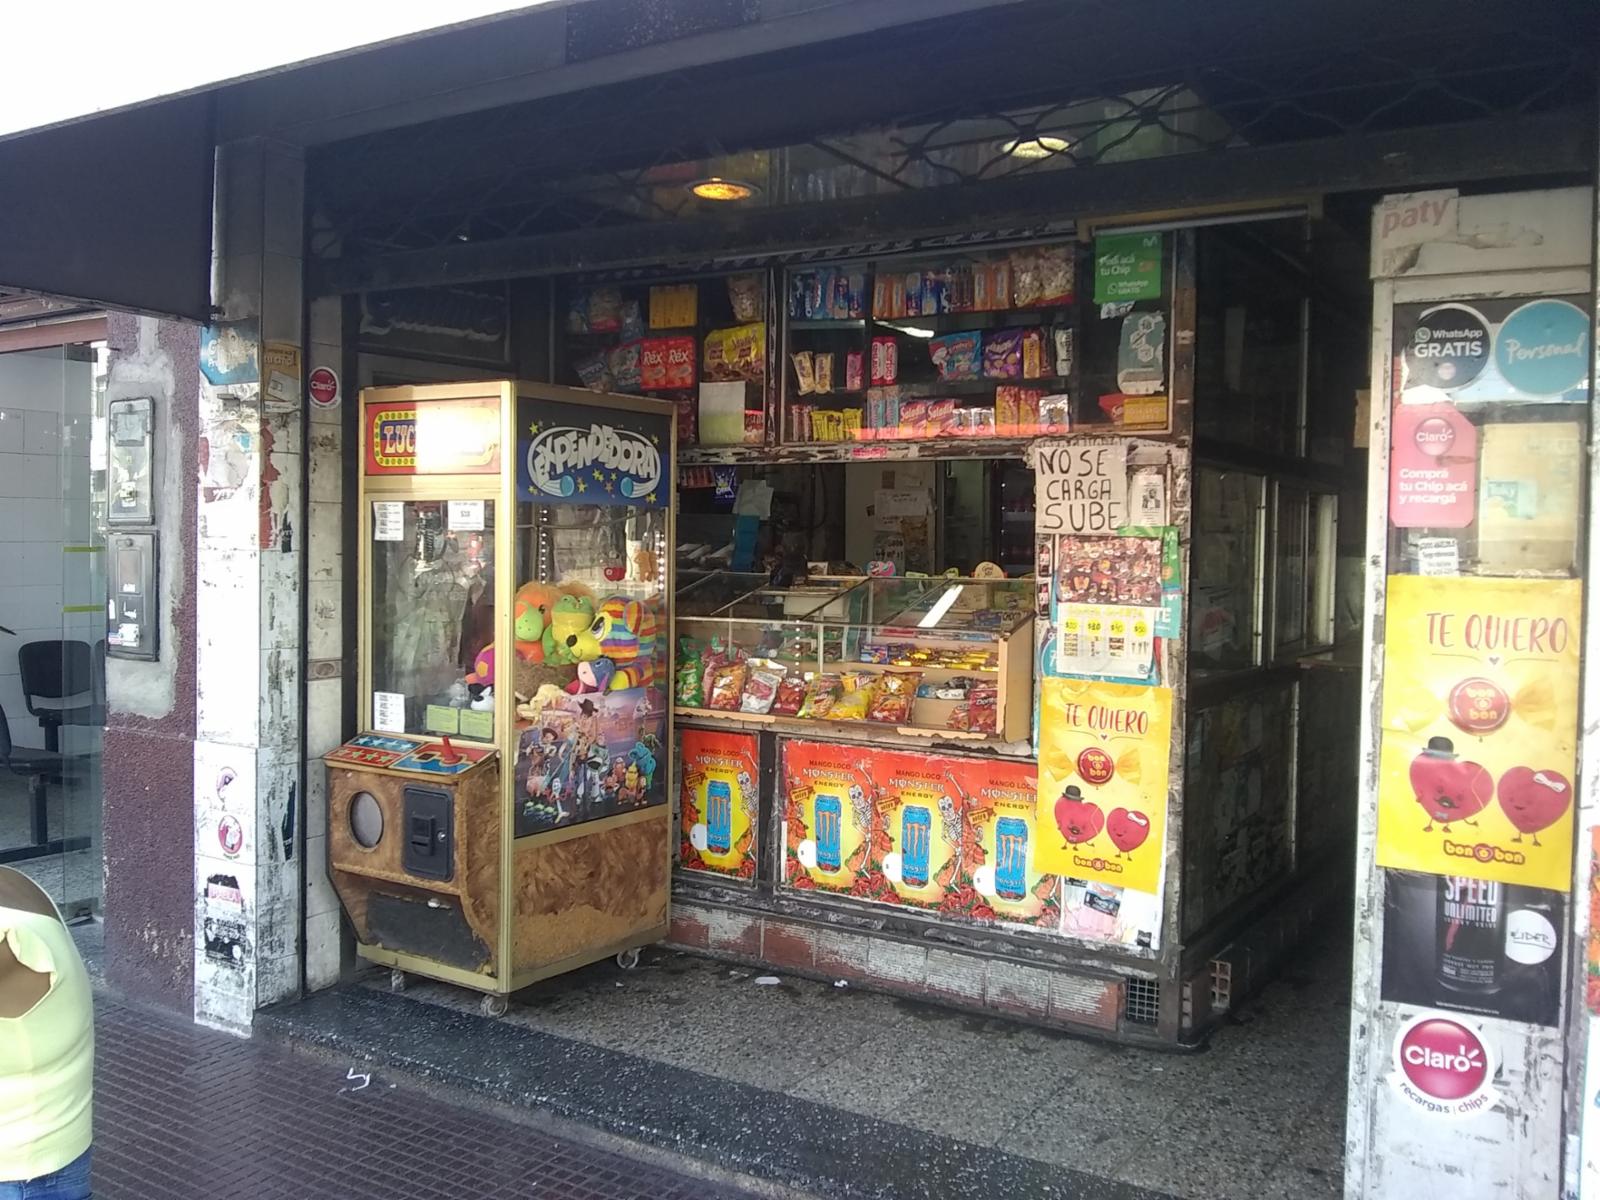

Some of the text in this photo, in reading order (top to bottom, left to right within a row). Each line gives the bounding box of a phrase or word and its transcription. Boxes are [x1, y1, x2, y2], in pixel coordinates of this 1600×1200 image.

[1382, 198, 1449, 238] paty
[1432, 328, 1483, 339] WhatsApp
[1414, 341, 1482, 358] GRATIS
[1505, 331, 1587, 365] Personal
[1416, 428, 1450, 442] Claro
[534, 423, 657, 484] EXPENDEDORA
[1039, 448, 1108, 477] NO SE
[1046, 478, 1112, 501] CARGA
[1400, 479, 1468, 493] tu Chip acá
[1399, 494, 1408, 504] y
[1043, 501, 1122, 531] SUBE
[1427, 612, 1568, 653] TE QUIERO
[1465, 687, 1496, 699] bon
[1066, 703, 1149, 735] TE QUIERO
[1469, 705, 1498, 720] bon
[701, 748, 722, 756] MANGO
[1088, 753, 1105, 762] bon
[695, 755, 744, 769] MONSTER
[809, 760, 851, 770] MANGO LOCO
[803, 768, 857, 782] MONSTER
[896, 769, 941, 780] MANGO LOCO
[1090, 768, 1107, 777] bon
[814, 780, 844, 788] ENERGY
[888, 778, 945, 793] MONSTER
[989, 779, 1016, 788] MANGO
[901, 791, 934, 799] ENERGY
[994, 802, 1030, 810] ENERGY
[1444, 876, 1498, 906] SPEED
[1444, 901, 1497, 923] UNLIMITED
[1405, 1045, 1474, 1072] Claro
[1400, 1082, 1488, 1114] recargas chips
